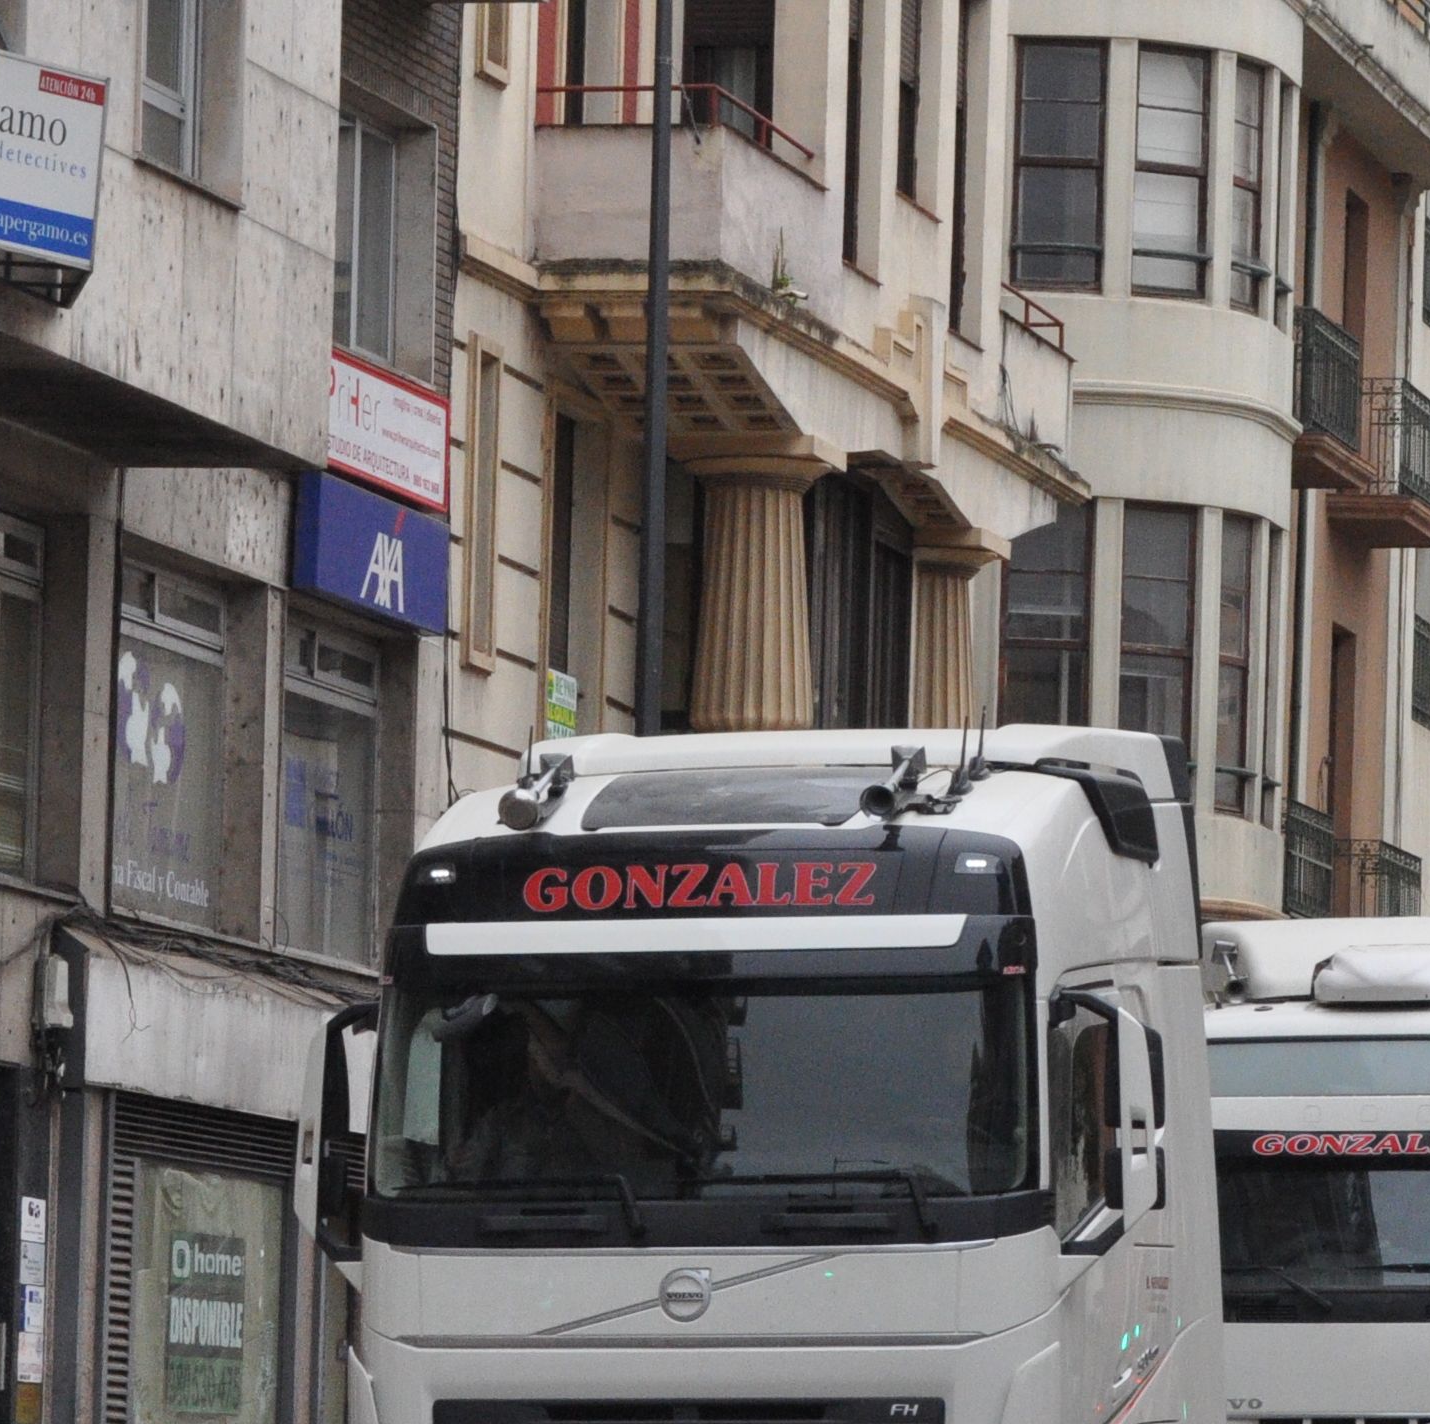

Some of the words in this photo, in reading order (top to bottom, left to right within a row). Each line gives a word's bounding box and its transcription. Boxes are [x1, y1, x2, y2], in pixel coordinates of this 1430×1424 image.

[40, 75, 79, 98] ATENCIÓN
[79, 85, 96, 102] 24h
[352, 441, 362, 462] DE
[359, 532, 404, 614] AXA
[166, 870, 210, 908] Contable
[523, 862, 877, 913] GONZALEZ
[666, 1292, 704, 1300] VOLVO
[169, 1297, 243, 1349] DISPONIBLE
[890, 1403, 920, 1416] FH
